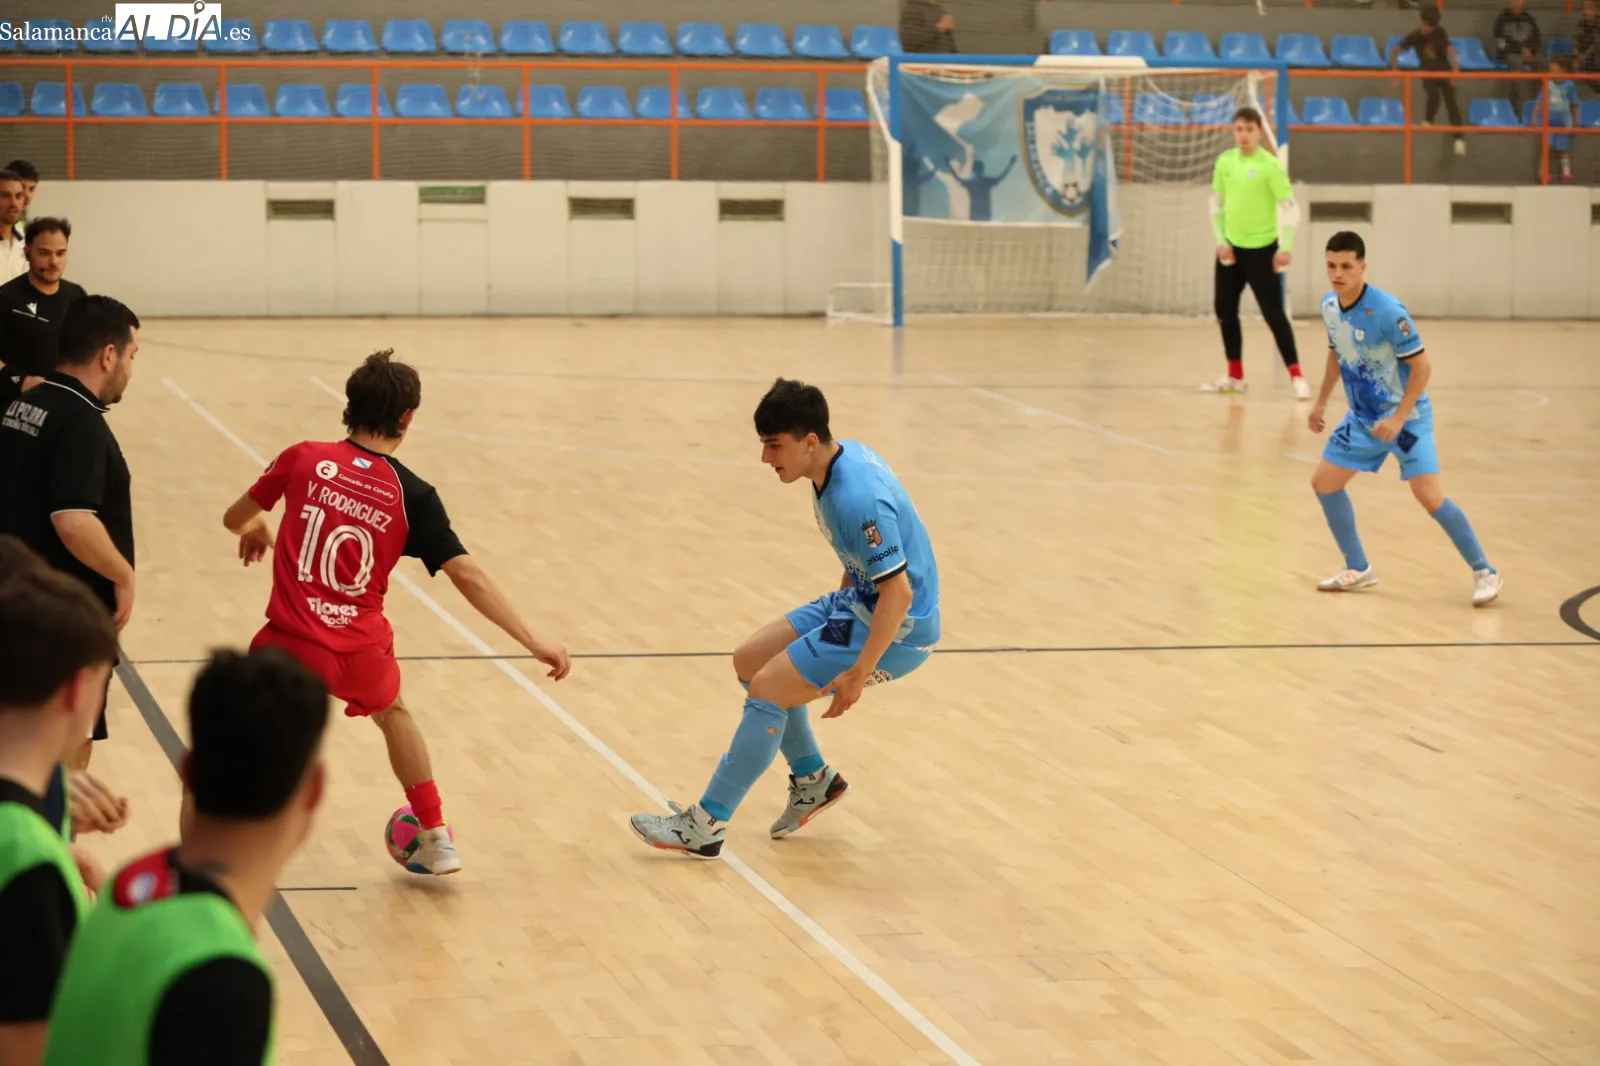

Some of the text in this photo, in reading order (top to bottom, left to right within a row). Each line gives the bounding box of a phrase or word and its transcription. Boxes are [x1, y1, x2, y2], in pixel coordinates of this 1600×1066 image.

[307, 481, 392, 533] V. RODRIGUEZ
[338, 473, 363, 487] Concello
[372, 486, 394, 499] Coruña
[298, 504, 374, 597] 10
